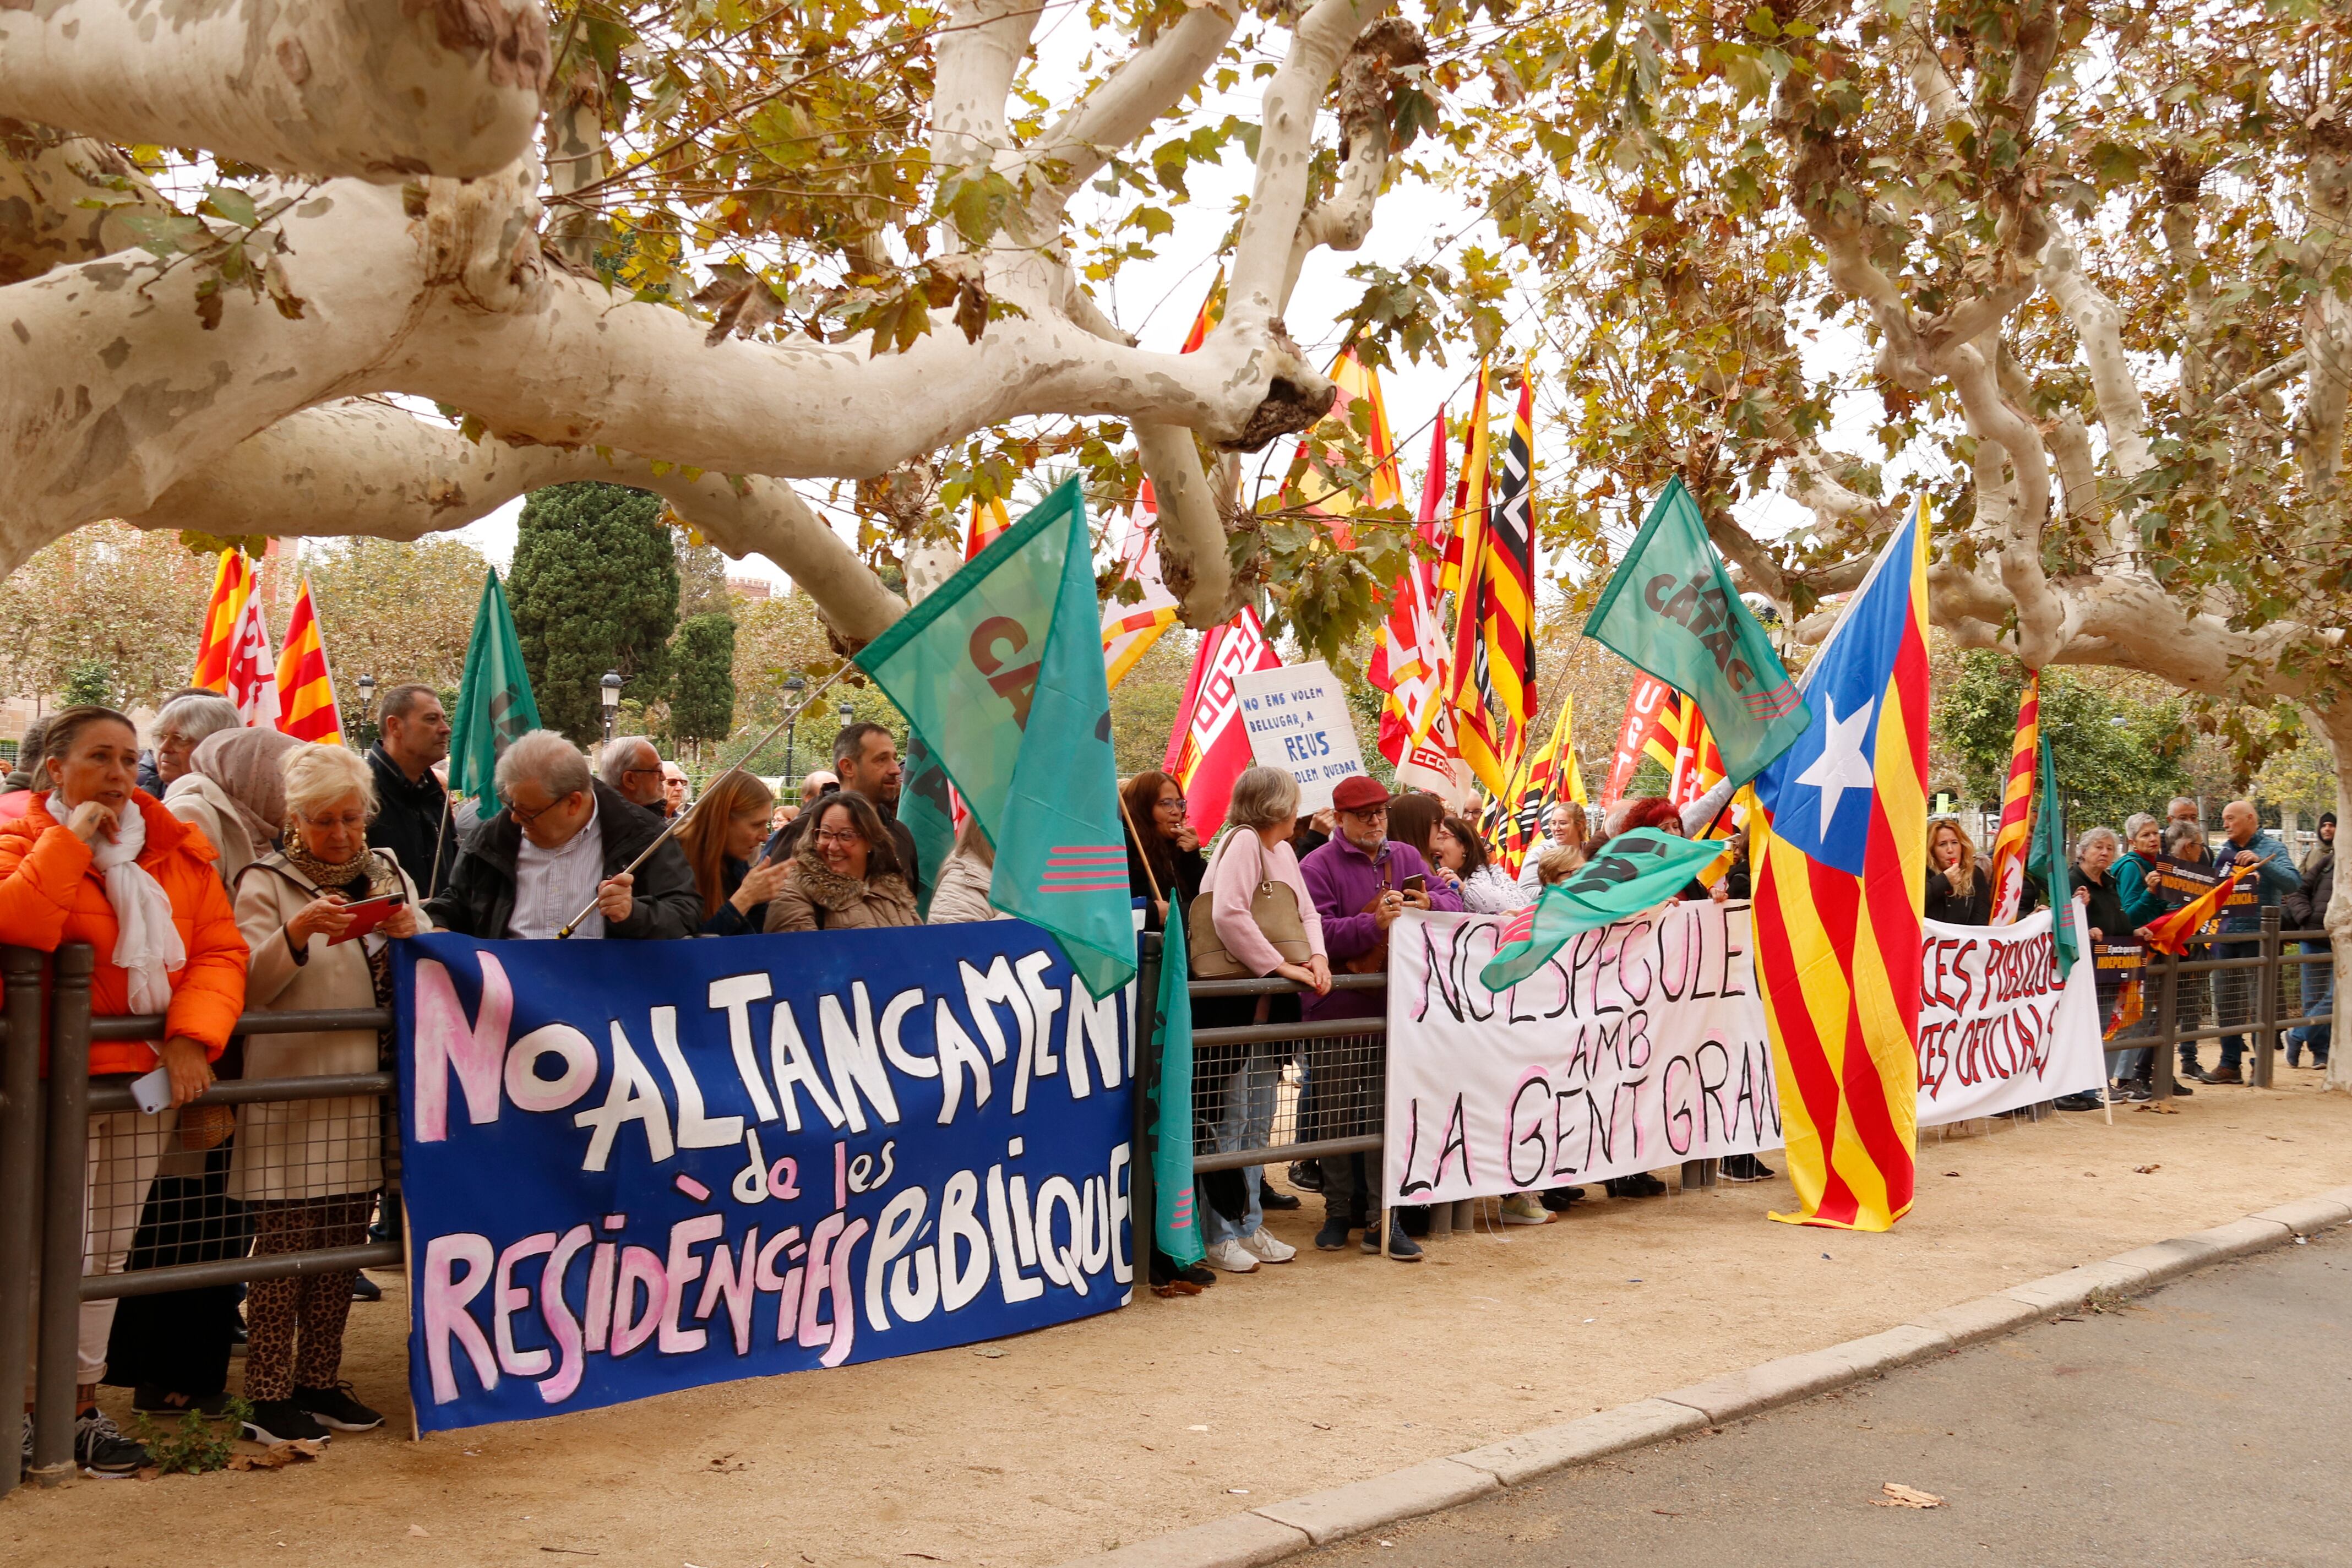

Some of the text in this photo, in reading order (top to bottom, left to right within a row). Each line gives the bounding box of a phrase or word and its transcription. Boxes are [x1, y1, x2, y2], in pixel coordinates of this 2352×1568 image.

[1645, 574, 1755, 693] CATAC
[1243, 687, 1324, 712] NO ENS VOLEM
[1306, 711, 1314, 722] A
[1284, 731, 1330, 763] REUS
[1292, 760, 1358, 784] OLEM QUEDAR
[1413, 750, 1449, 775] CCOO
[1412, 905, 1762, 1026] NO SPECULE
[1919, 936, 1978, 1017] CES
[1567, 1009, 1652, 1079] AMB
[1956, 999, 2060, 1087] OFICIALS
[575, 1006, 744, 1172] AL
[1400, 1039, 1783, 1198] LA GENT GRAN
[732, 1129, 895, 1210] de les
[865, 1137, 1133, 1331] PÚBLIQUE
